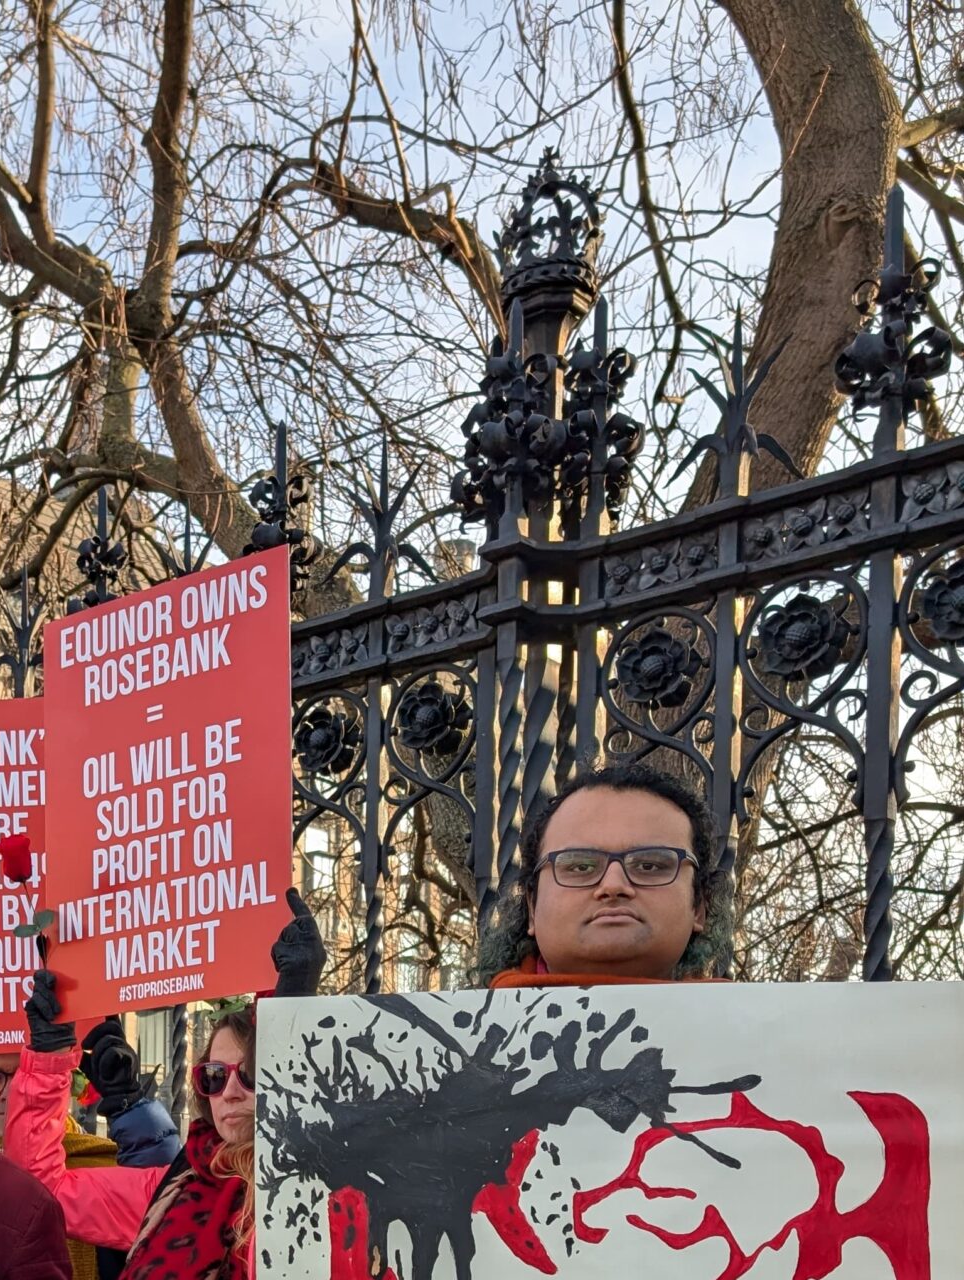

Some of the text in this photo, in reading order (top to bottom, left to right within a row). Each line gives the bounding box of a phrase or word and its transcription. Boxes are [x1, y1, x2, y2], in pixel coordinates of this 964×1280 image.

[59, 564, 267, 669] EQUINOR OWNS
[84, 623, 232, 707] ROSEBANK
[82, 718, 242, 799] OIL WILL BE
[96, 772, 227, 842] SOLD FOR
[92, 818, 233, 890] PROFIT ON
[2, 893, 39, 932] BY
[58, 860, 276, 944] INTERNATIONAL
[104, 919, 220, 982] MARKET
[119, 973, 204, 1002] #STOPROSEBANK
